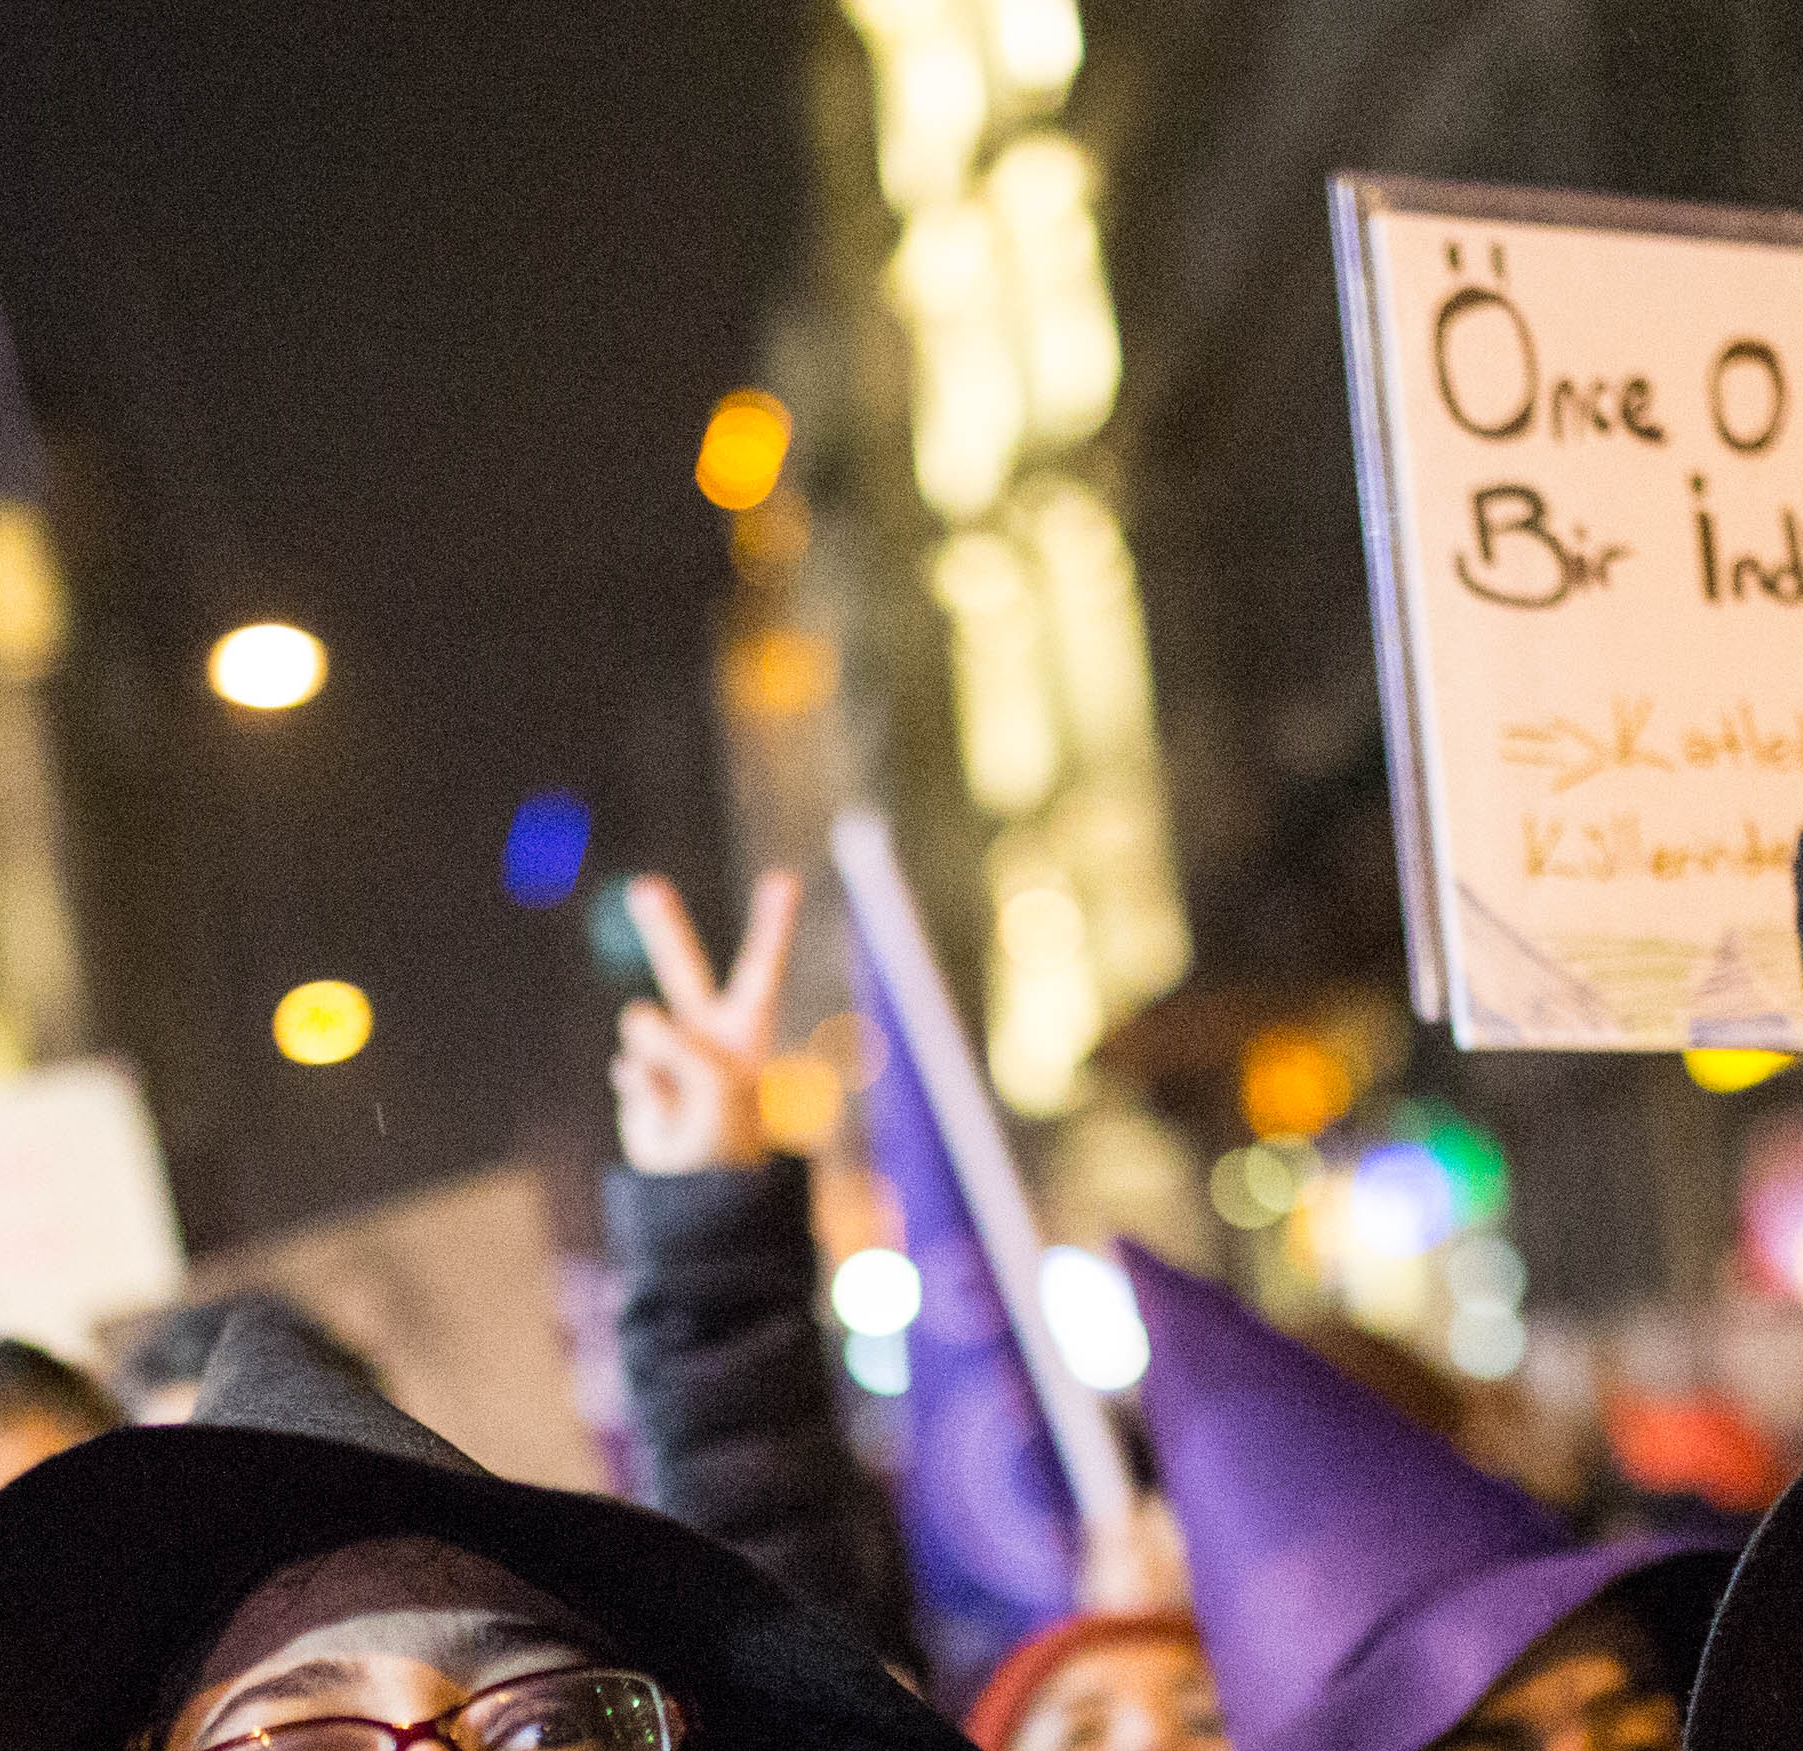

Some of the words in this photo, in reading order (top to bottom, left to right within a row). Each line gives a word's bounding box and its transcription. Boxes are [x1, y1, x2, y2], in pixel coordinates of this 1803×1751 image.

[1430, 242, 1667, 446] Önce
[1707, 334, 1791, 456] O
[1454, 482, 1625, 610] Bir
